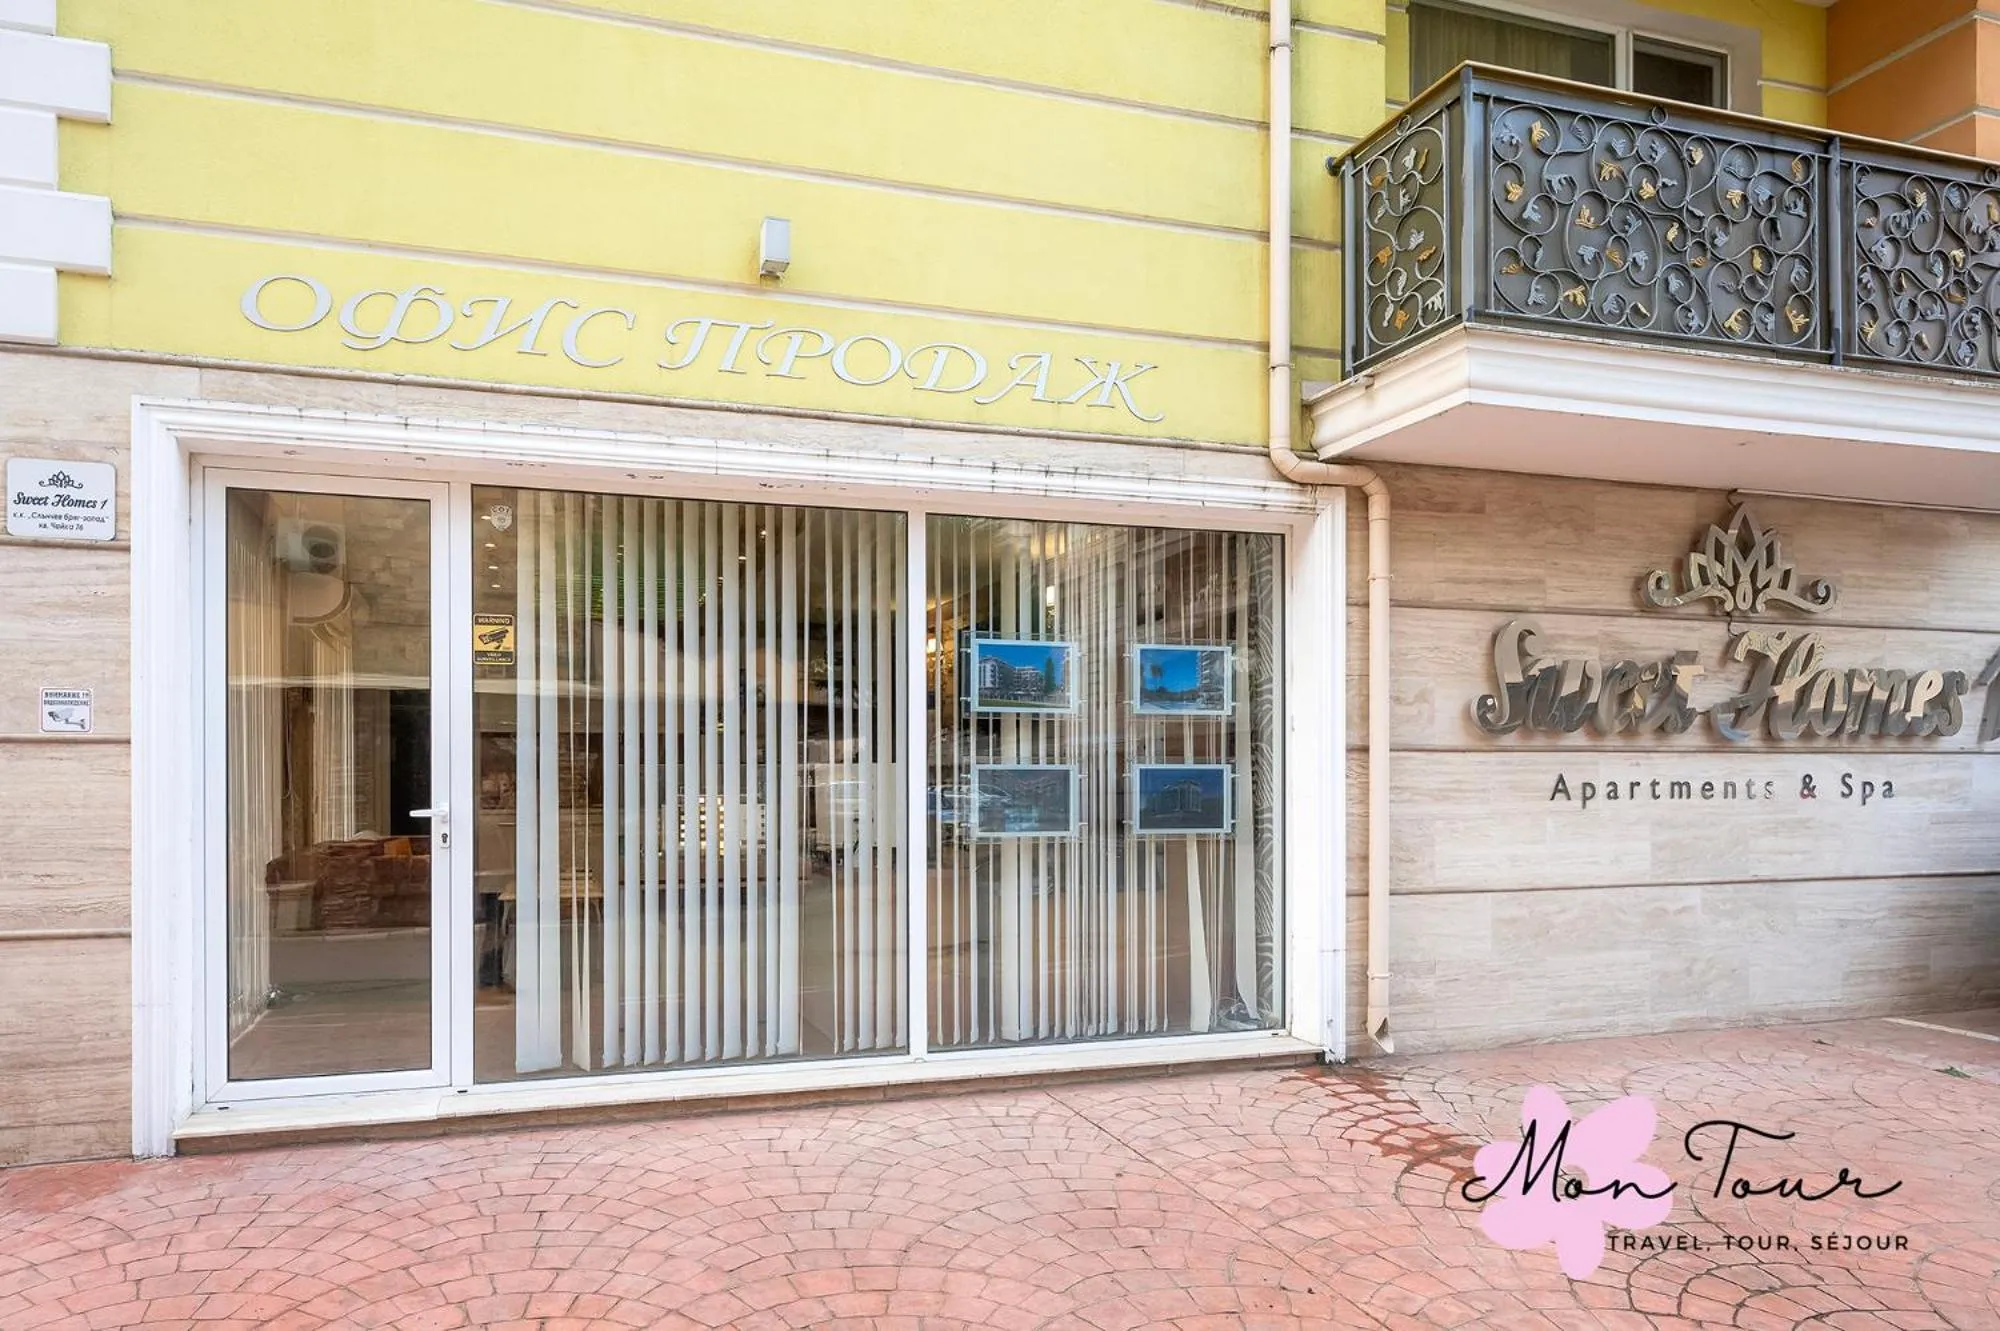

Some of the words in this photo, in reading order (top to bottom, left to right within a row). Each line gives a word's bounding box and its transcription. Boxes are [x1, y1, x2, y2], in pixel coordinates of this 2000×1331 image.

[240, 275, 636, 369] ОФИС
[656, 316, 1165, 423] ПРОДАЖ
[13, 491, 50, 506] Sweet
[51, 494, 98, 509] Homes
[478, 617, 510, 625] WARNING
[1470, 615, 1705, 740] Sweet
[1707, 630, 1970, 743] Homes
[1550, 772, 1775, 808] Apartments
[1799, 774, 1818, 799] &
[1841, 772, 1897, 807] Spa
